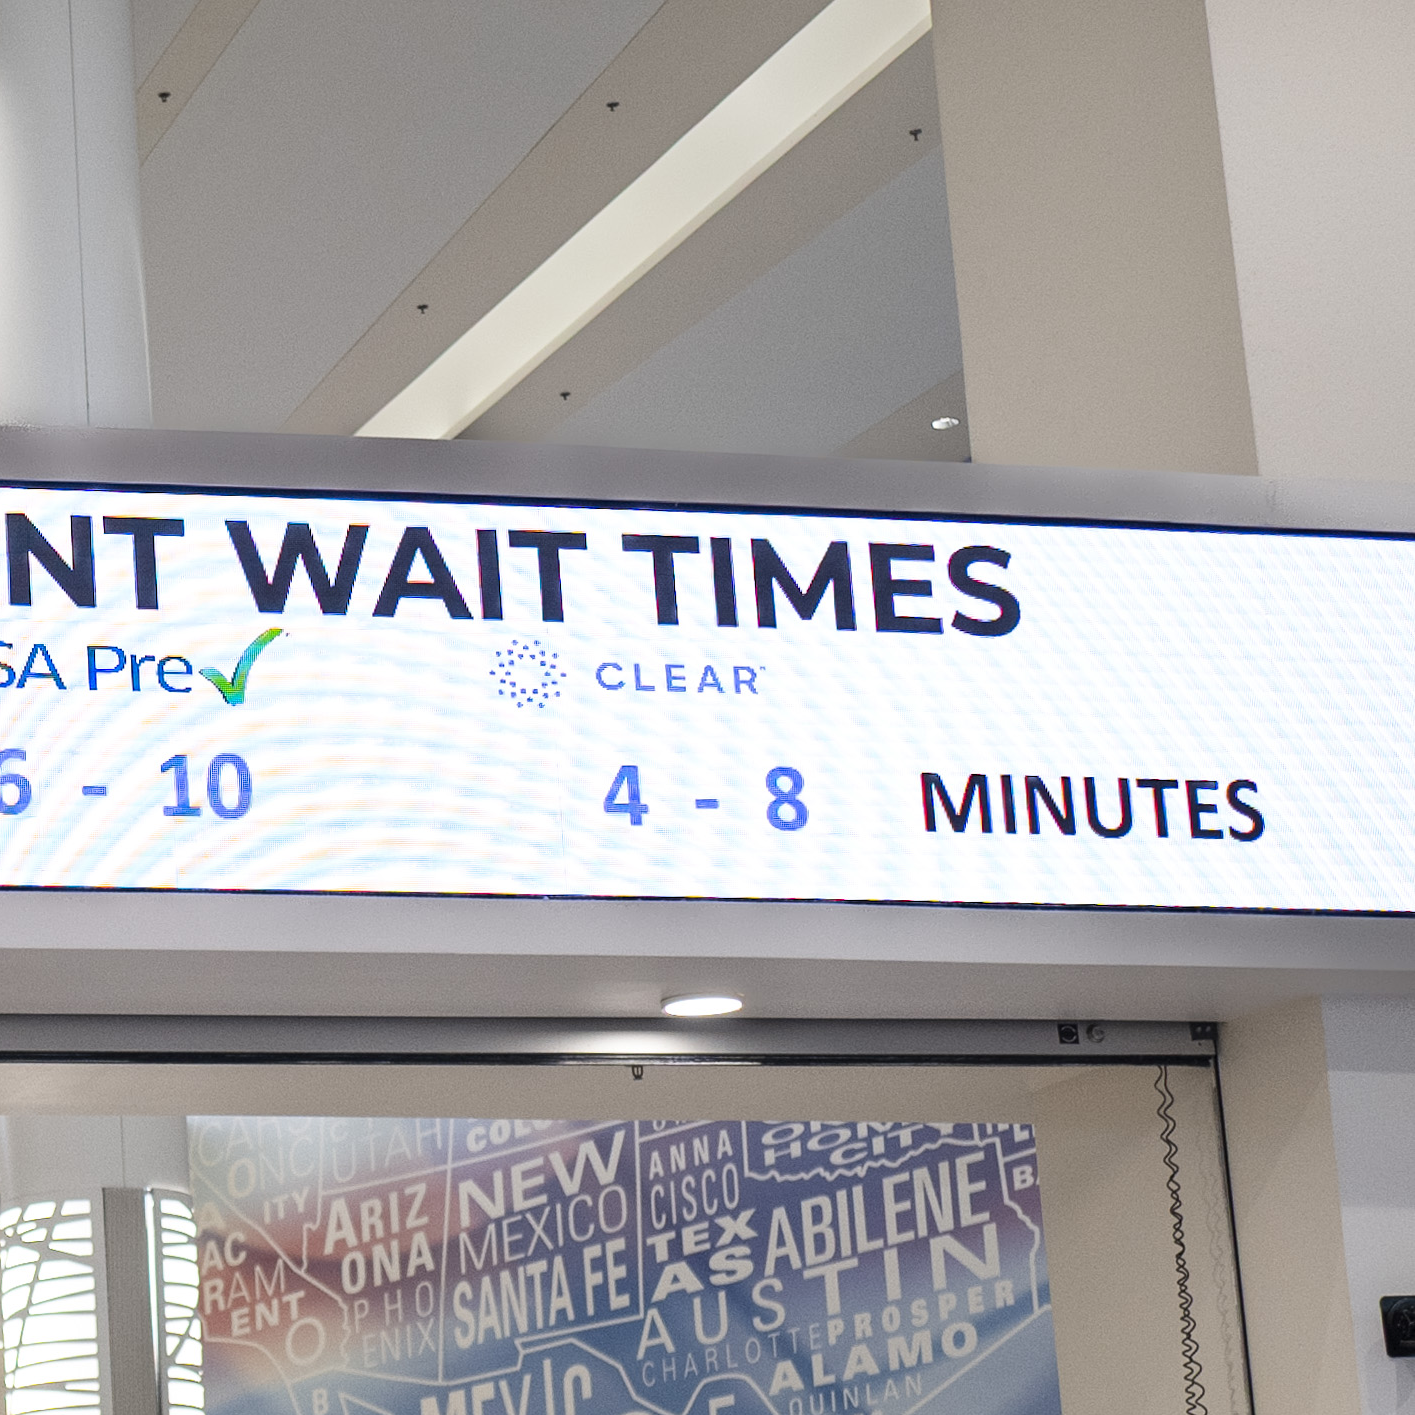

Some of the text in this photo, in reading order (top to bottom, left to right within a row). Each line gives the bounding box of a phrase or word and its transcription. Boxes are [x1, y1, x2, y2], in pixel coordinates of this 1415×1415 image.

[224, 518, 588, 624] WAIT
[620, 532, 1024, 638] TIMES
[85, 643, 194, 693] Pre
[159, 752, 254, 820] 10
[602, 765, 649, 827] 4
[763, 765, 811, 832] 8
[918, 771, 1267, 843] MINUTES
[458, 1130, 627, 1222] NEW
[648, 1128, 734, 1181] ANNA
[324, 1182, 431, 1257] ARIZ
[458, 1184, 630, 1275] MEXICO
[650, 1162, 740, 1231] CISCO
[764, 1151, 992, 1279] ABILENE
[341, 1229, 436, 1296] ONA
[646, 1207, 759, 1263] TEX
[453, 1236, 632, 1351] SANTA FE
[635, 1221, 1003, 1361] AUSTIN
[650, 1244, 756, 1304] AS
[826, 1278, 1017, 1347] PROSPER
[640, 1322, 822, 1389] CHARLOTTE
[769, 1320, 979, 1397] ALAMO
